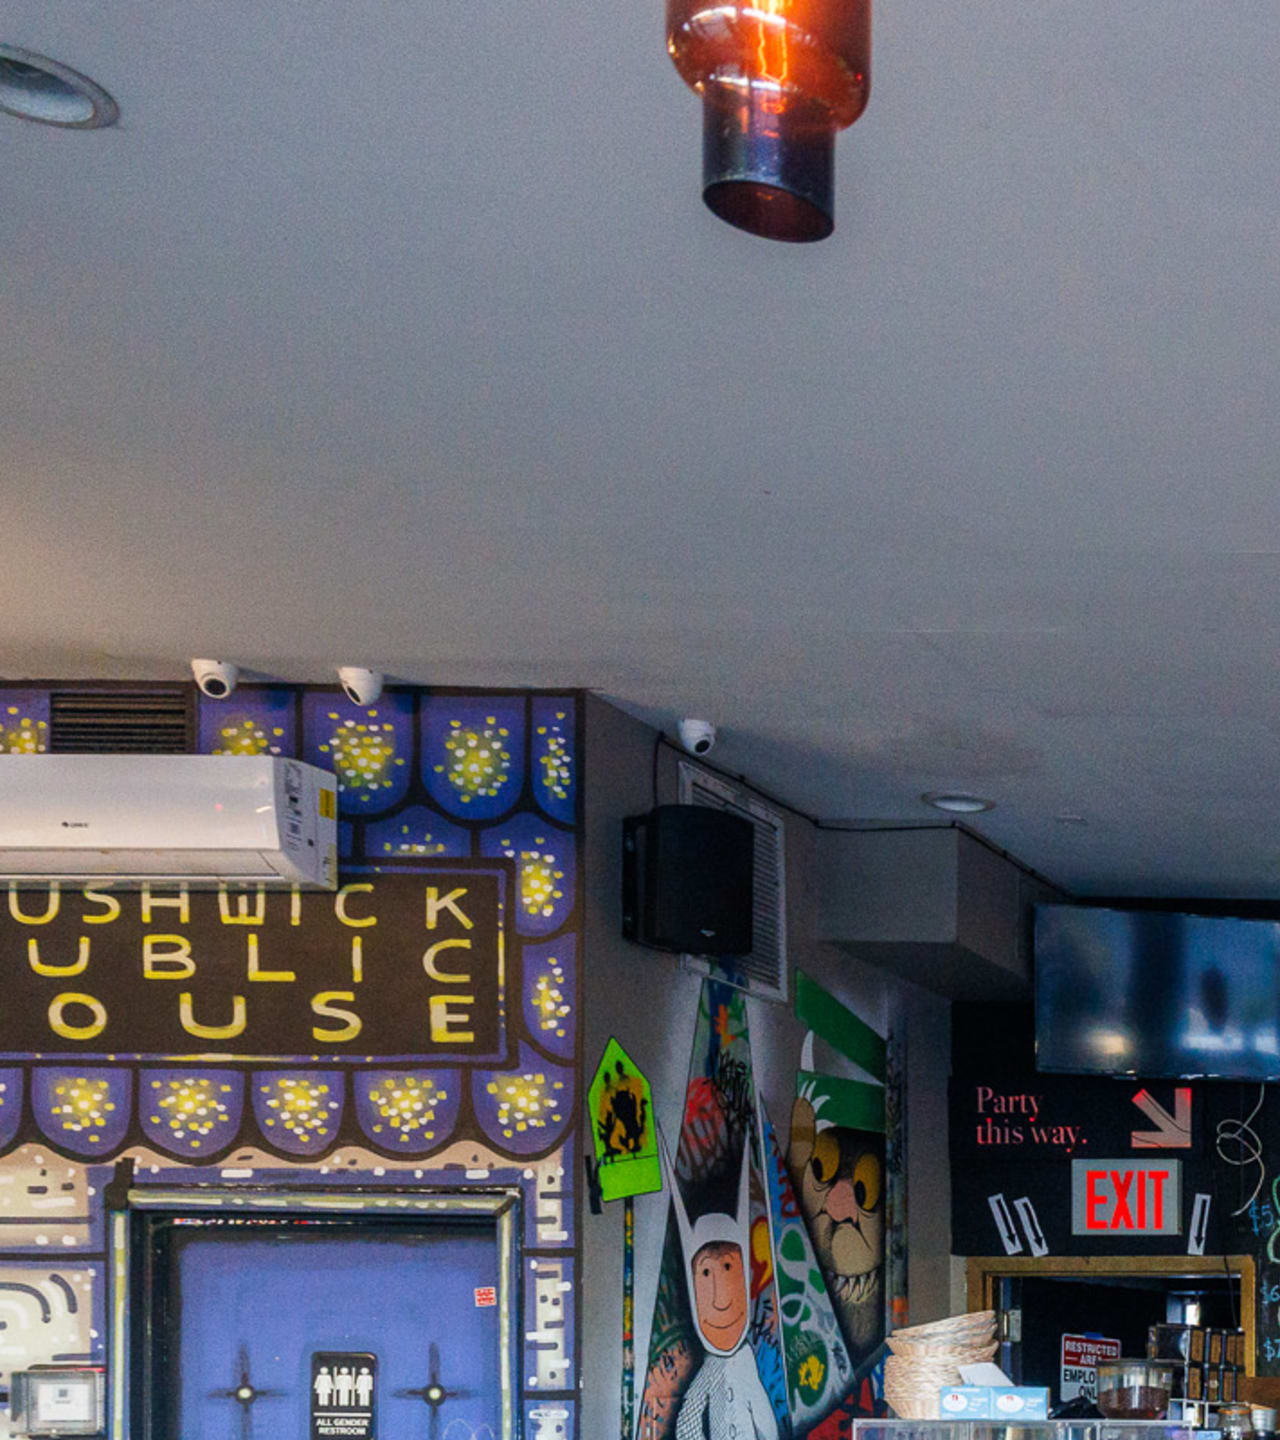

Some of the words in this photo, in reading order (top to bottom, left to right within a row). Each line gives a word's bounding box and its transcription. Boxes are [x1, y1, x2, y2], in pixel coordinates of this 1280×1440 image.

[976, 1085, 1040, 1122] Party
[976, 1117, 1025, 1145] this
[1031, 1124, 1088, 1153] way.
[1085, 1170, 1169, 1230] EXIT
[1064, 1341, 1118, 1357] RESTRICTED
[316, 1418, 333, 1427] ALL
[333, 1418, 370, 1427] GENDER
[318, 1427, 367, 1436] RESTROOM
